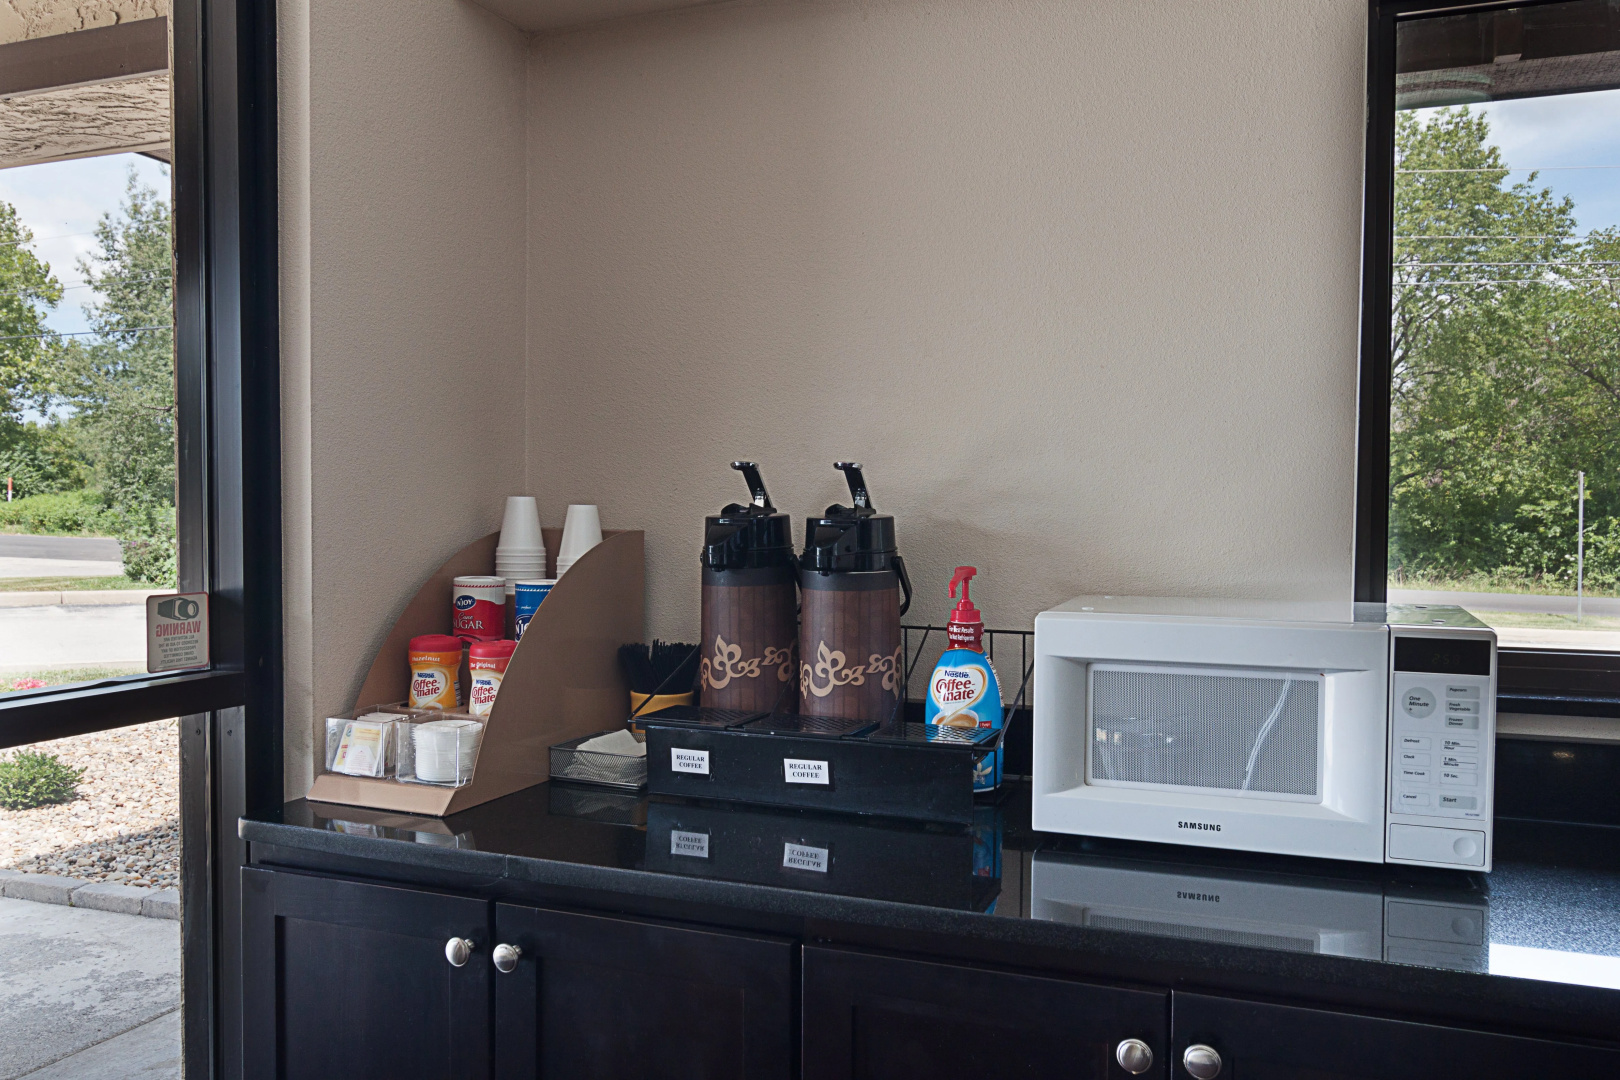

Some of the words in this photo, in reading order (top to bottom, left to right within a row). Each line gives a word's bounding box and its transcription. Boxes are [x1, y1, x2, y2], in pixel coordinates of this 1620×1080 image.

[457, 612, 474, 621] Cane
[416, 686, 440, 698] mate
[942, 689, 976, 702] mate
[474, 694, 496, 705] mate
[676, 754, 705, 762] REGULAR
[679, 761, 703, 769] COFFEE
[789, 763, 822, 771] REGULAR
[792, 771, 820, 779] COFFEE
[1177, 820, 1222, 832] SAMSUNG
